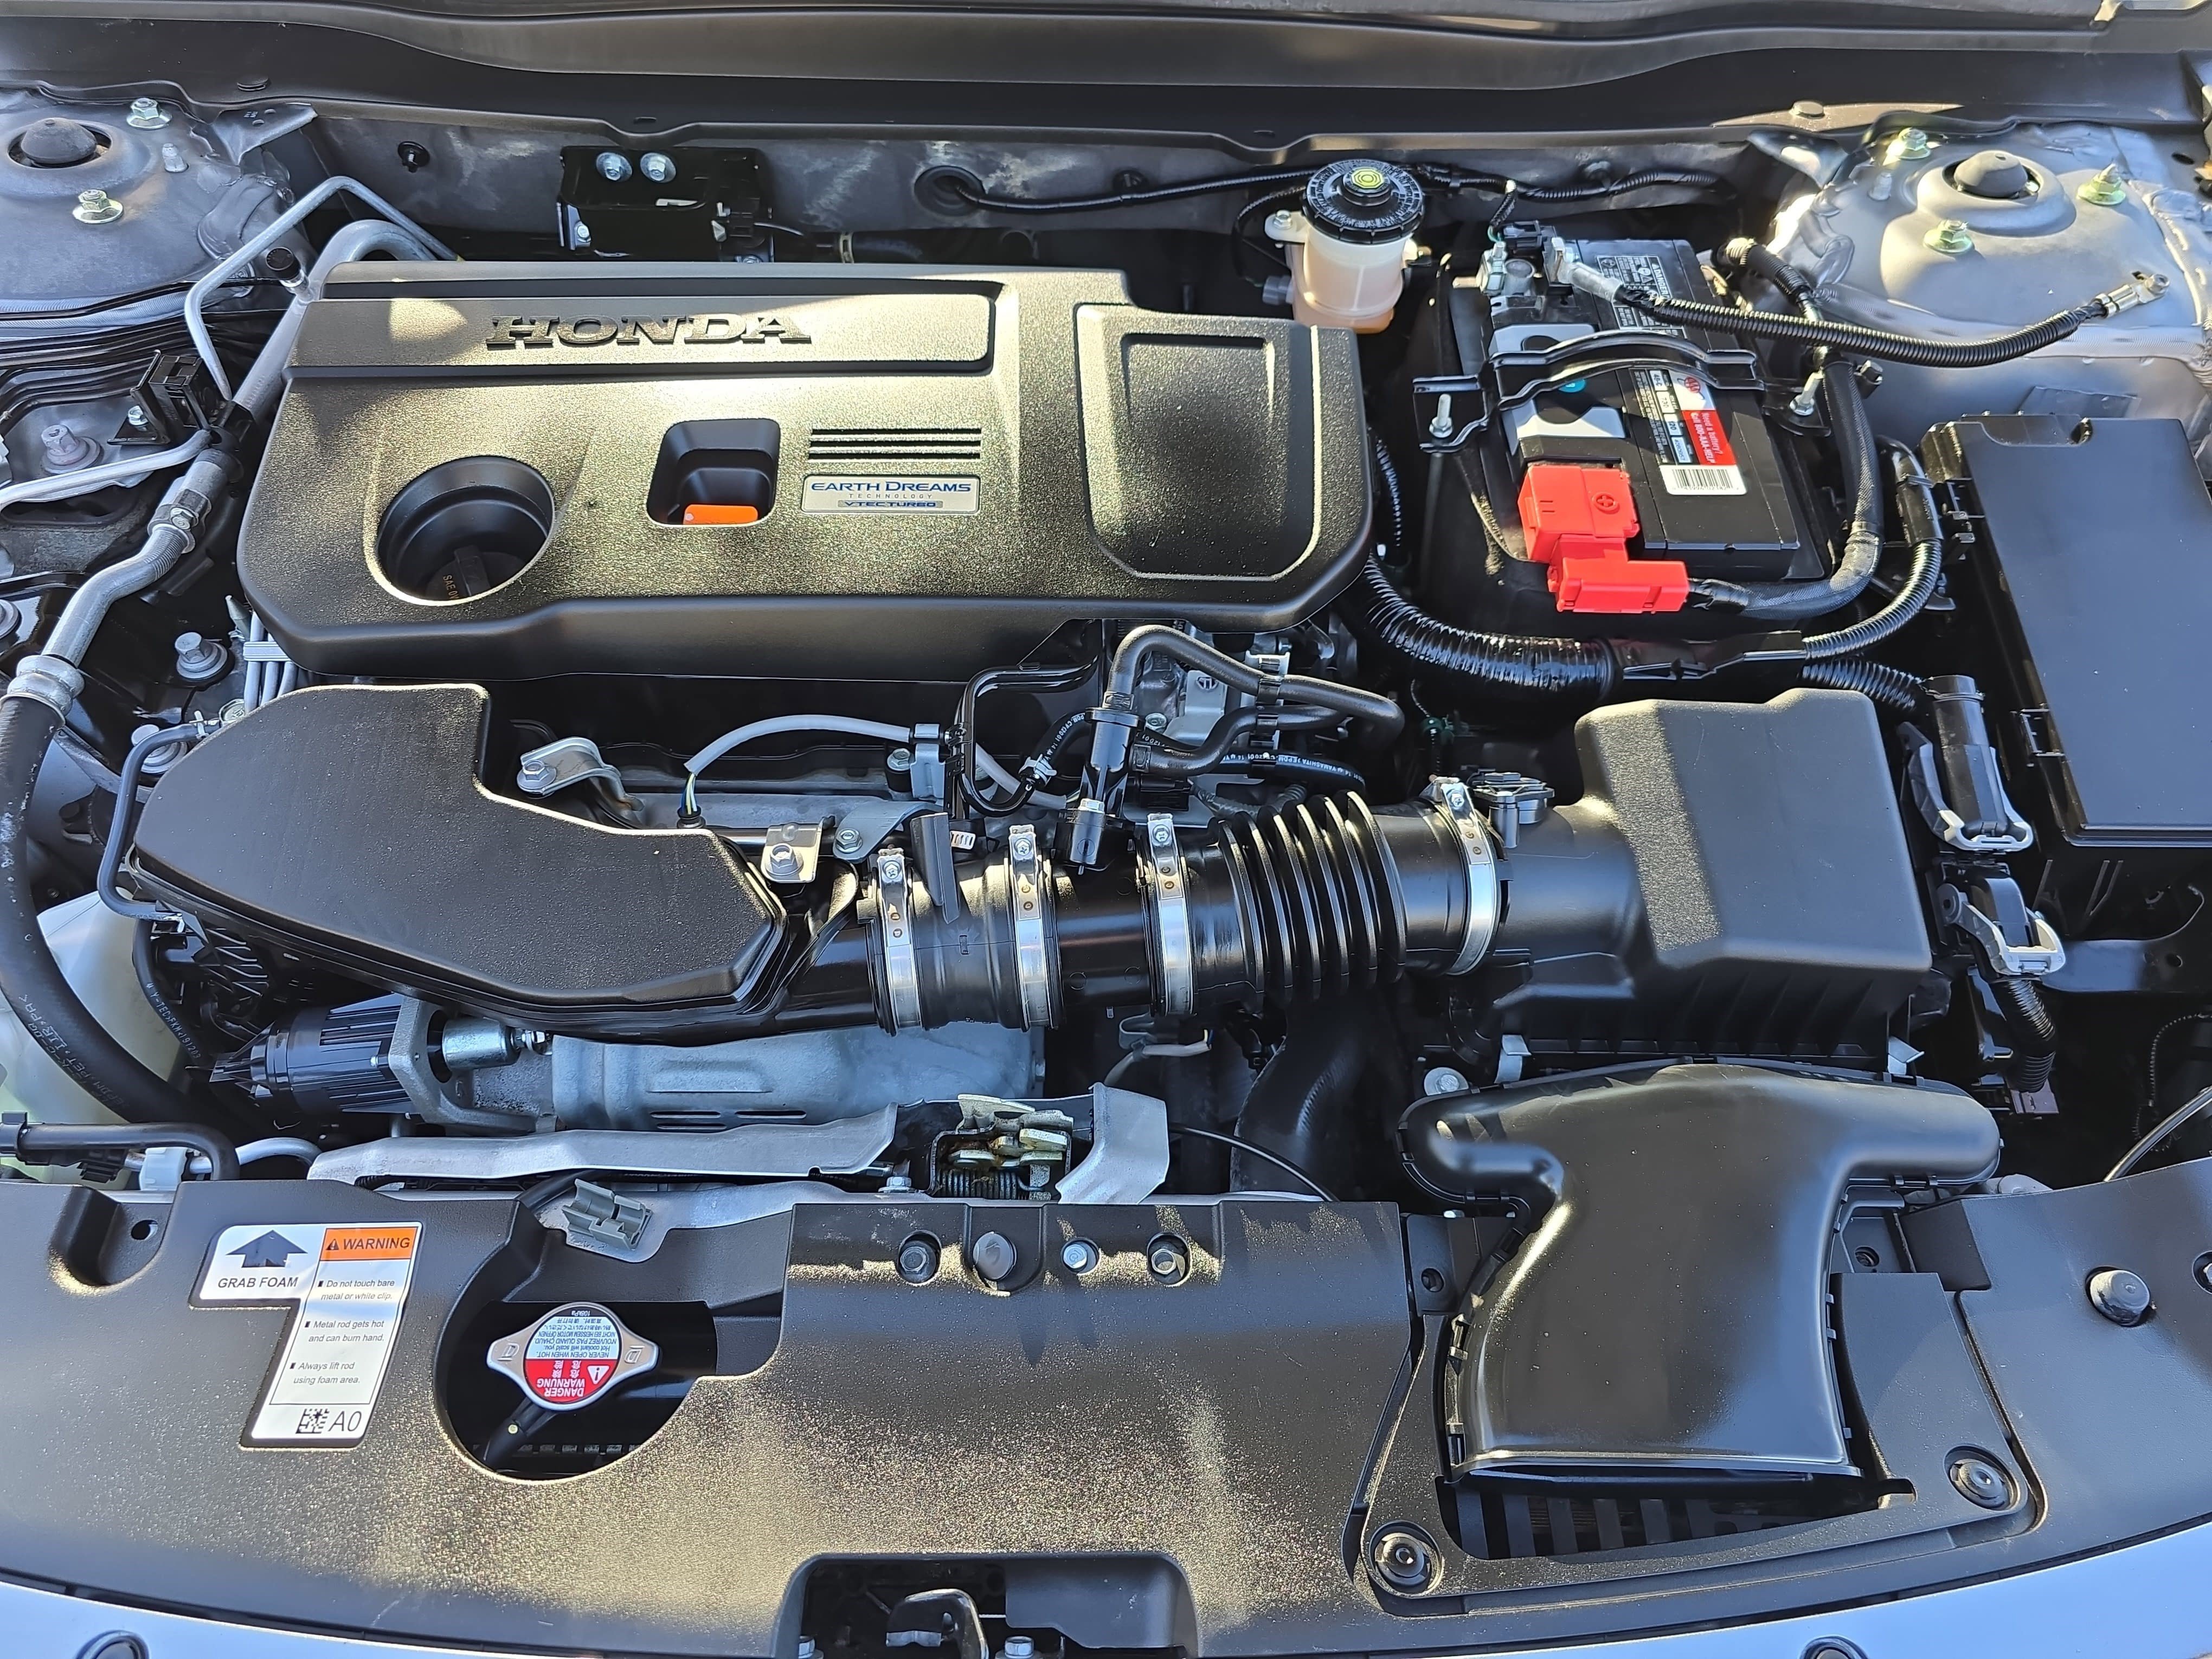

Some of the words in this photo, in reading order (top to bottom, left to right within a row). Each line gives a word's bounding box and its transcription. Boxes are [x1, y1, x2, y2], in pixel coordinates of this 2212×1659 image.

[486, 314, 812, 350] HONDA
[811, 482, 880, 492] EARTH
[885, 481, 971, 492] DREAMS
[443, 575, 455, 590] SAE
[343, 1237, 410, 1250] WARNING
[217, 1277, 255, 1288] GRAB
[259, 1276, 299, 1287] FOAM
[376, 1292, 393, 1301] clip.
[313, 1320, 336, 1328] Metal
[352, 1321, 370, 1329] gets
[308, 1334, 324, 1342] and
[362, 1334, 384, 1342] hand.
[298, 1362, 327, 1371] Always
[293, 1377, 316, 1386] using
[317, 1376, 337, 1384] foam
[536, 1378, 585, 1387] WARNUNG
[544, 1387, 584, 1397] DANGER
[328, 1410, 362, 1433] A0
